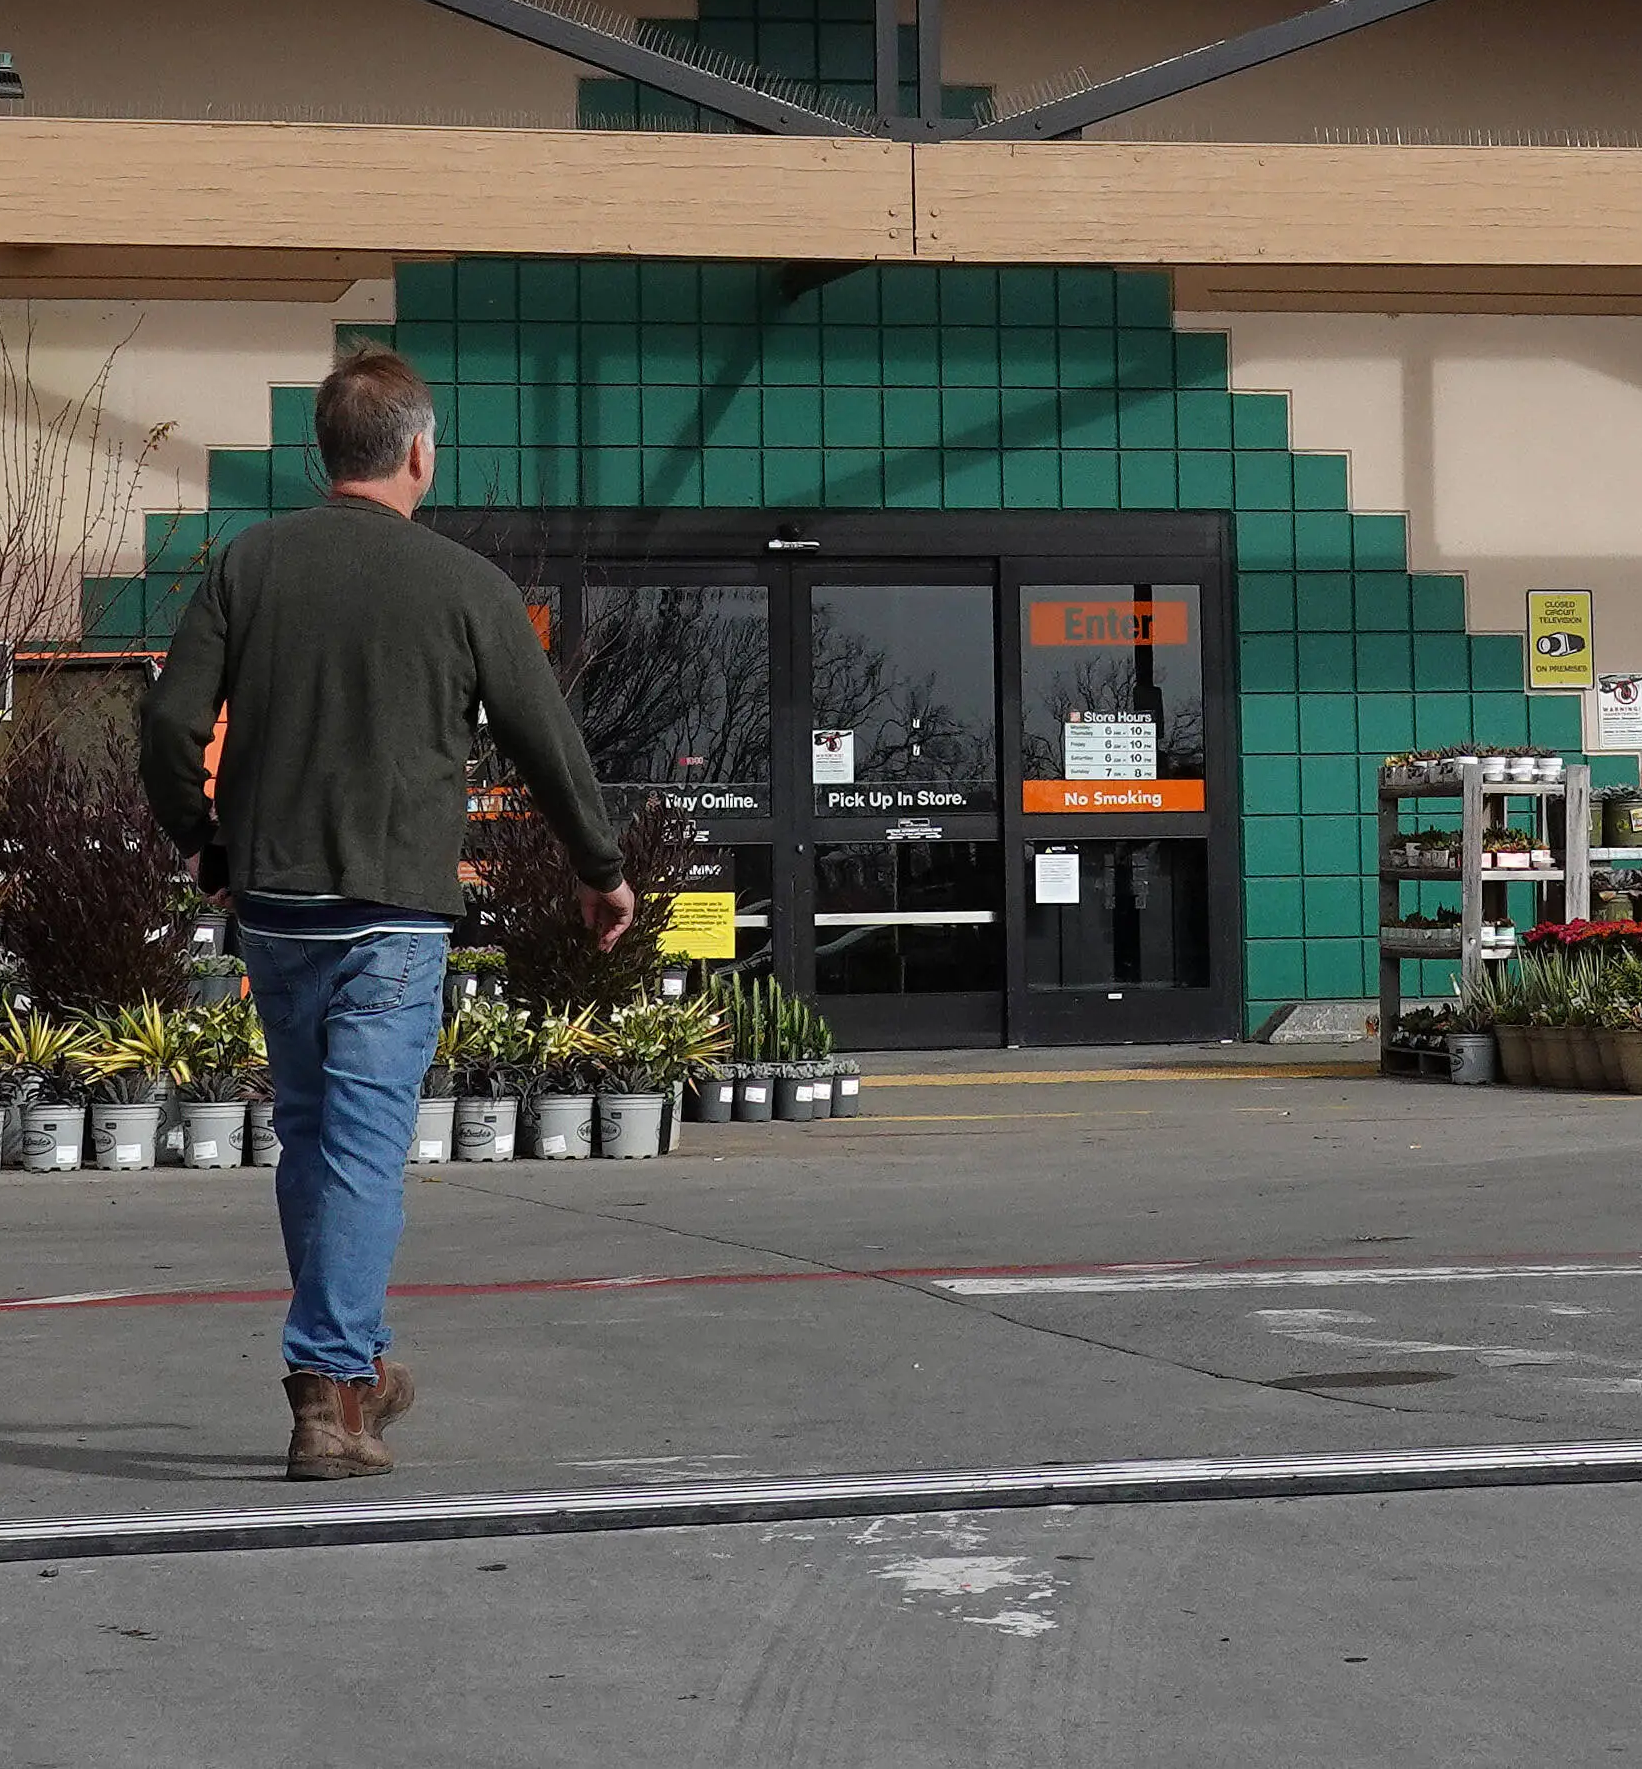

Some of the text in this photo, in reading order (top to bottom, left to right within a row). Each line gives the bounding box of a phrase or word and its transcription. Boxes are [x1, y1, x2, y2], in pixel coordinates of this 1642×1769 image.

[1544, 601, 1576, 609] CLOSED
[1065, 607, 1157, 641] Enter
[1539, 616, 1582, 624] TELEVISION
[1536, 664, 1588, 673] ON PREMISES
[1084, 711, 1116, 723] Store
[1117, 711, 1152, 723] Hours
[1105, 726, 1113, 736] 6
[1130, 726, 1143, 736] 10
[1105, 739, 1113, 749] 6
[1130, 740, 1143, 749] 10
[1105, 753, 1112, 763] 6
[1130, 753, 1143, 763] 10
[1105, 768, 1112, 777] 7
[1134, 768, 1142, 778] 8
[701, 792, 759, 809] Online.
[828, 790, 967, 810] Pick Up In Store.
[1064, 790, 1163, 808] No Smoking
